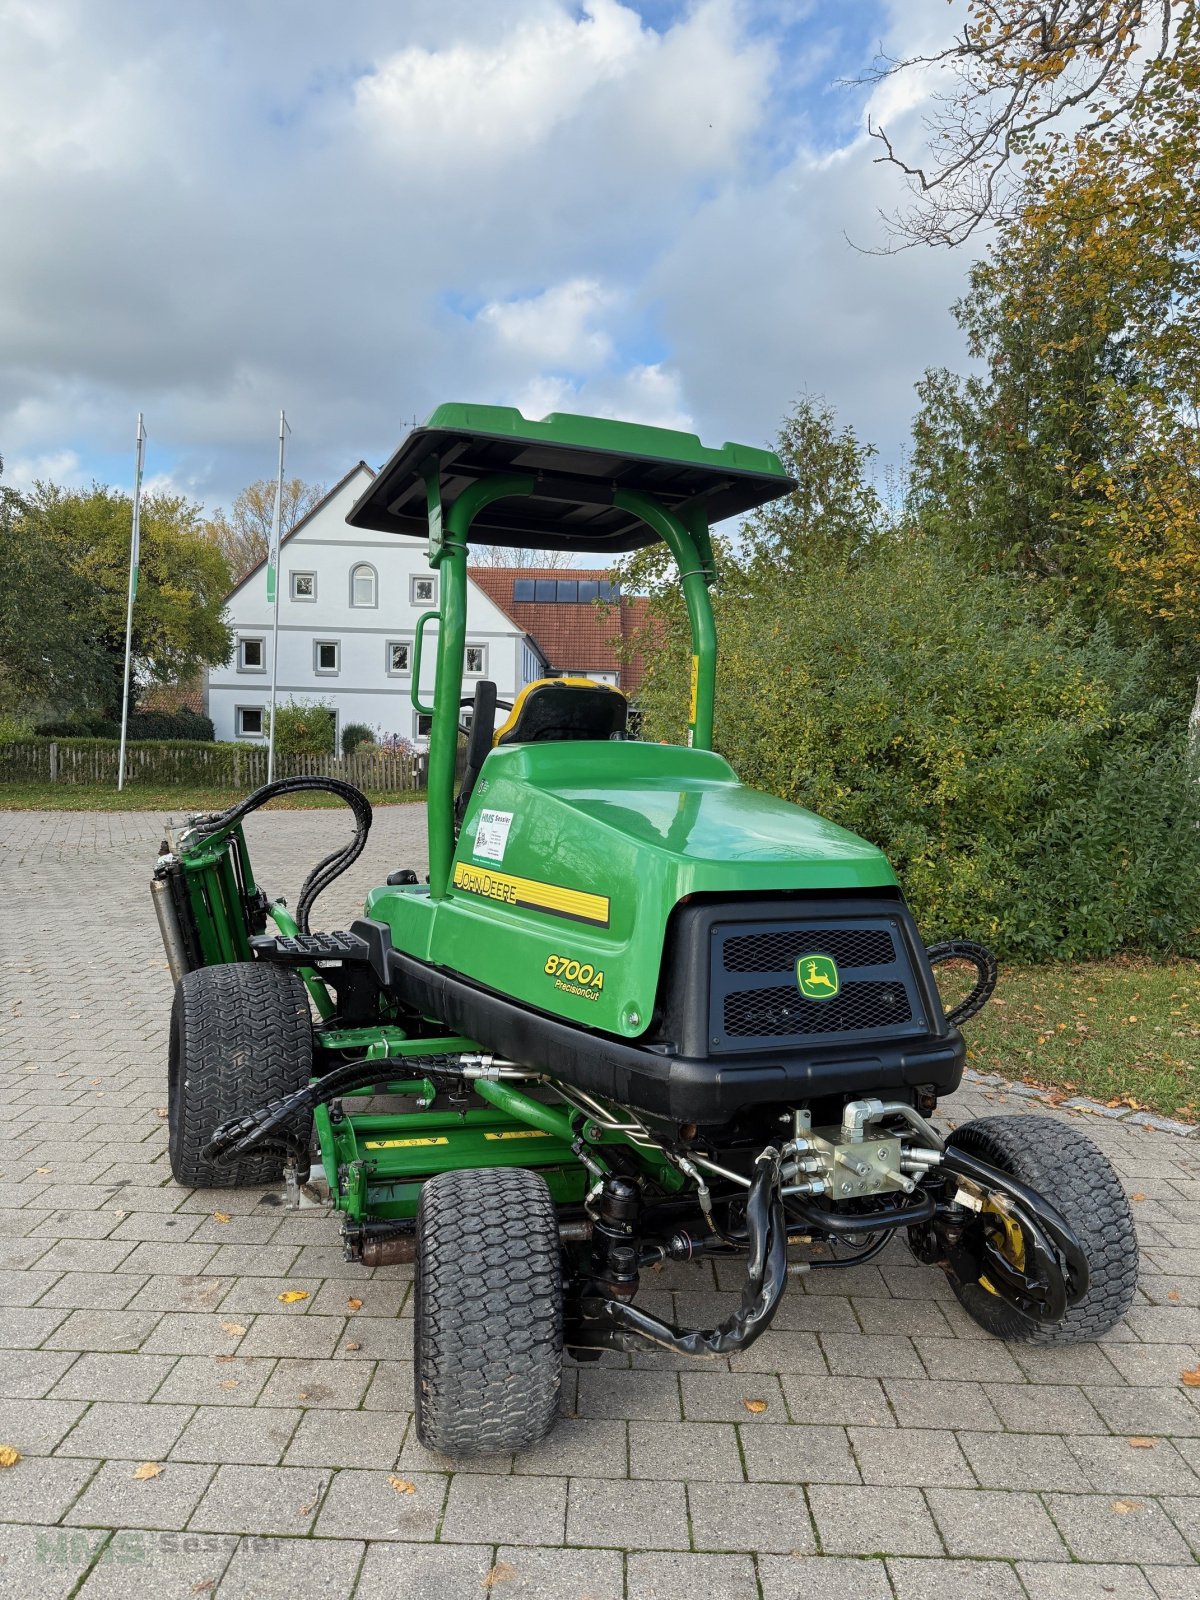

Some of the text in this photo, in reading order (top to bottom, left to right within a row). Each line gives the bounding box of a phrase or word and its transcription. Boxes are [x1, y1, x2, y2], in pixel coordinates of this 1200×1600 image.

[481, 813, 495, 824] HMS
[544, 954, 604, 989] 8700A
[555, 979, 600, 1001] PrecisionCut
